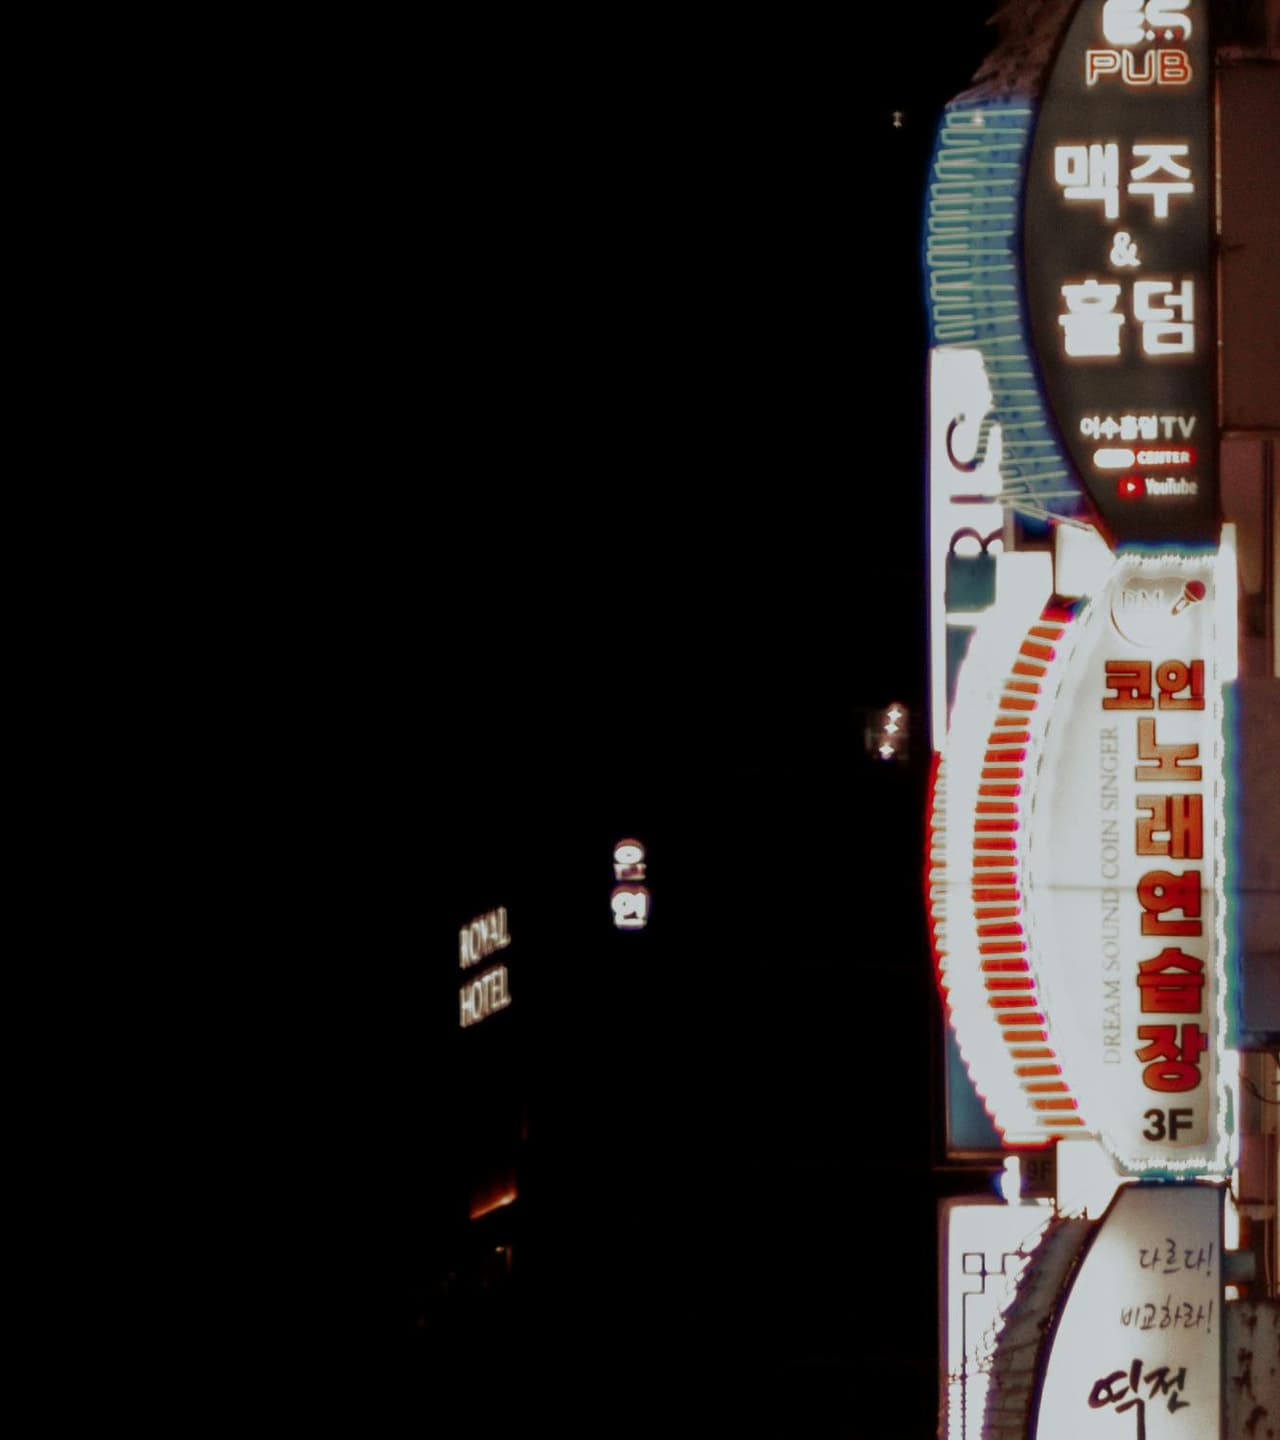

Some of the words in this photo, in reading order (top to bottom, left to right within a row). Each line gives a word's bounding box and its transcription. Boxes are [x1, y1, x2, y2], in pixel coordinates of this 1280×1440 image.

[1085, 49, 1193, 86] PUB
[1053, 142, 1195, 219] 맥주
[1109, 232, 1141, 267] &
[1058, 279, 1196, 358] 홀덤
[1144, 477, 1199, 496] YouTube
[1102, 659, 1206, 711] 코인
[1134, 717, 1208, 1093] 노래연습장
[458, 904, 512, 970] ROYAL
[458, 964, 512, 1029] HOTEL
[1141, 1108, 1193, 1142] 3F
[1138, 1240, 1215, 1274] 다르다!
[1121, 1301, 1215, 1335] 비교하라!
